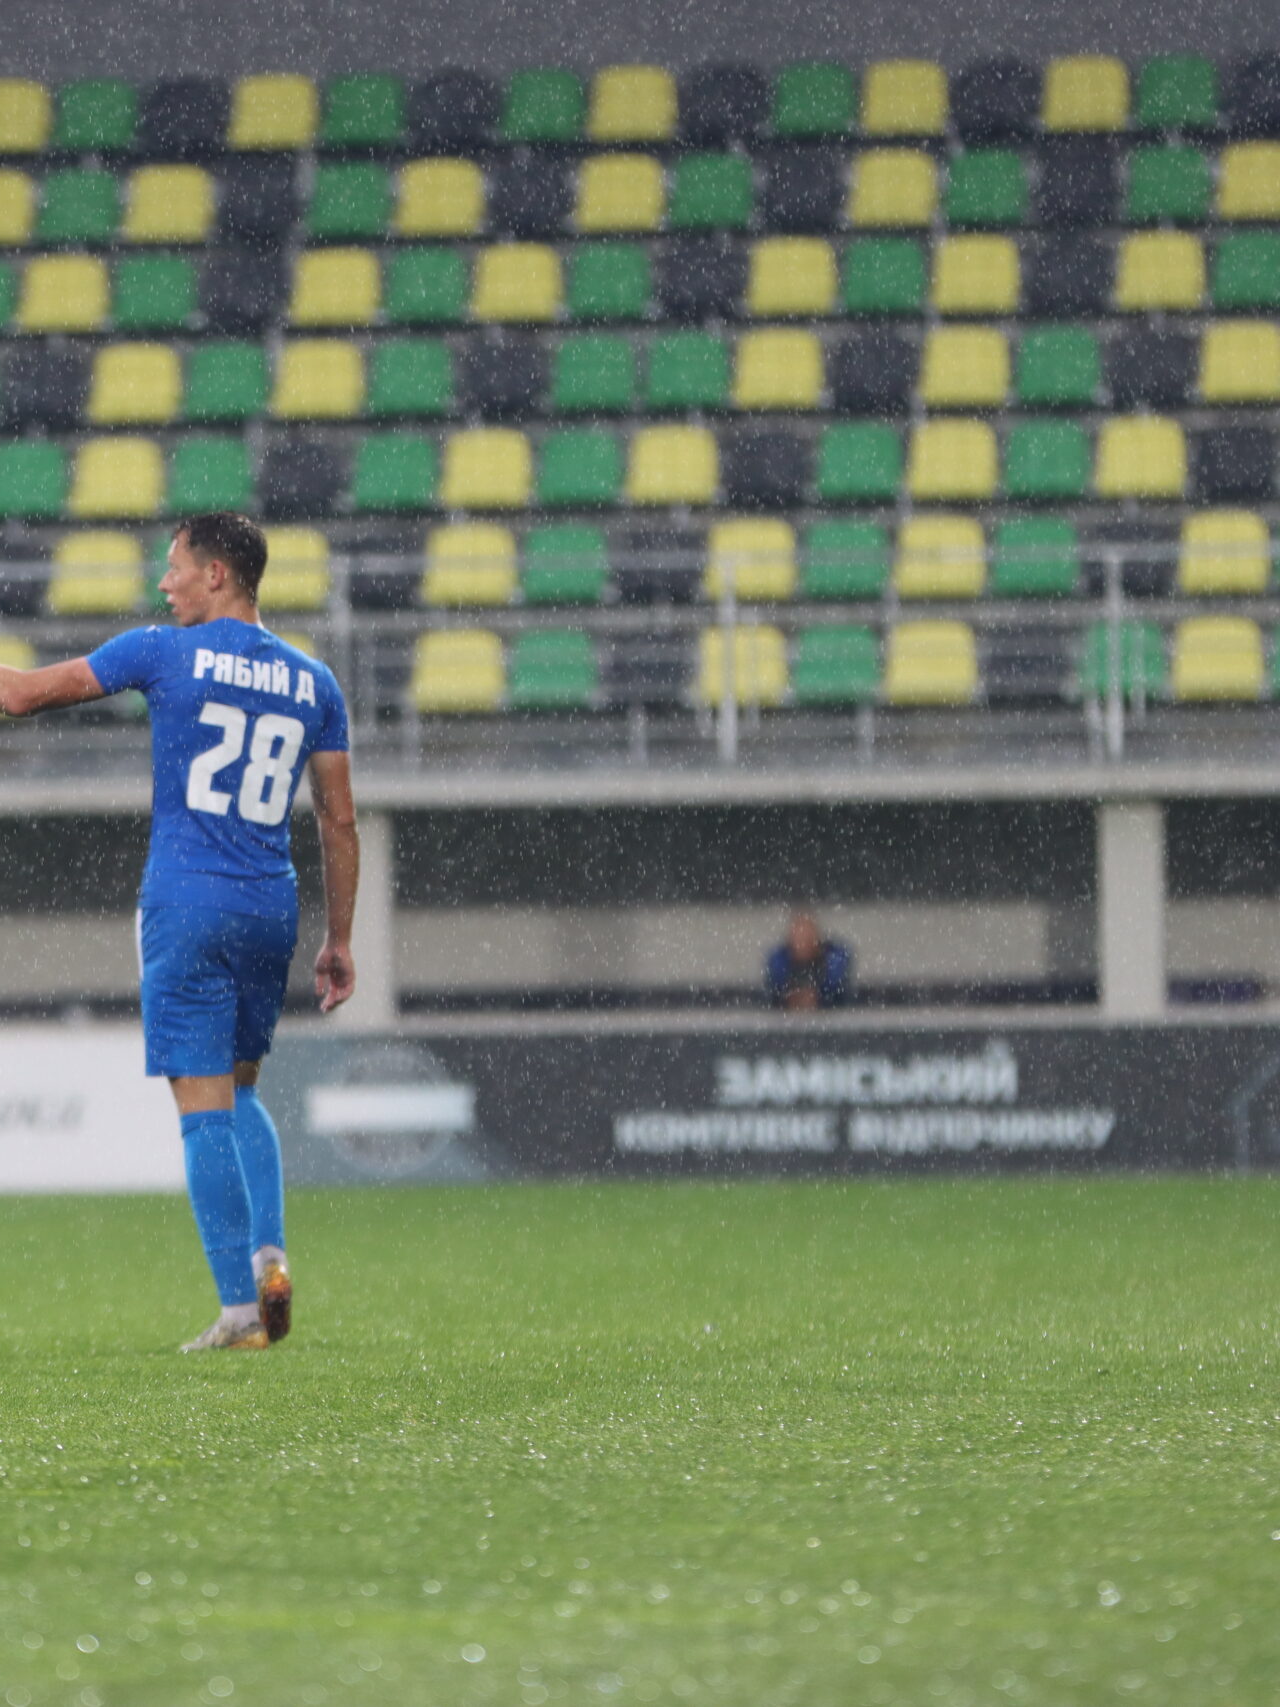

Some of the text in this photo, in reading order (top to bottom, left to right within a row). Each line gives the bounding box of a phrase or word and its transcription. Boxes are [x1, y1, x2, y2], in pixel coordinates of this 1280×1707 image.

[193, 648, 317, 707] РЯБИЙ Д
[186, 701, 305, 826] 28
[718, 1040, 1019, 1104] ЗАМІСЬКИЙ
[614, 1110, 1117, 1155] КОМПЛЕКС ВІДПОЧИНКУ
